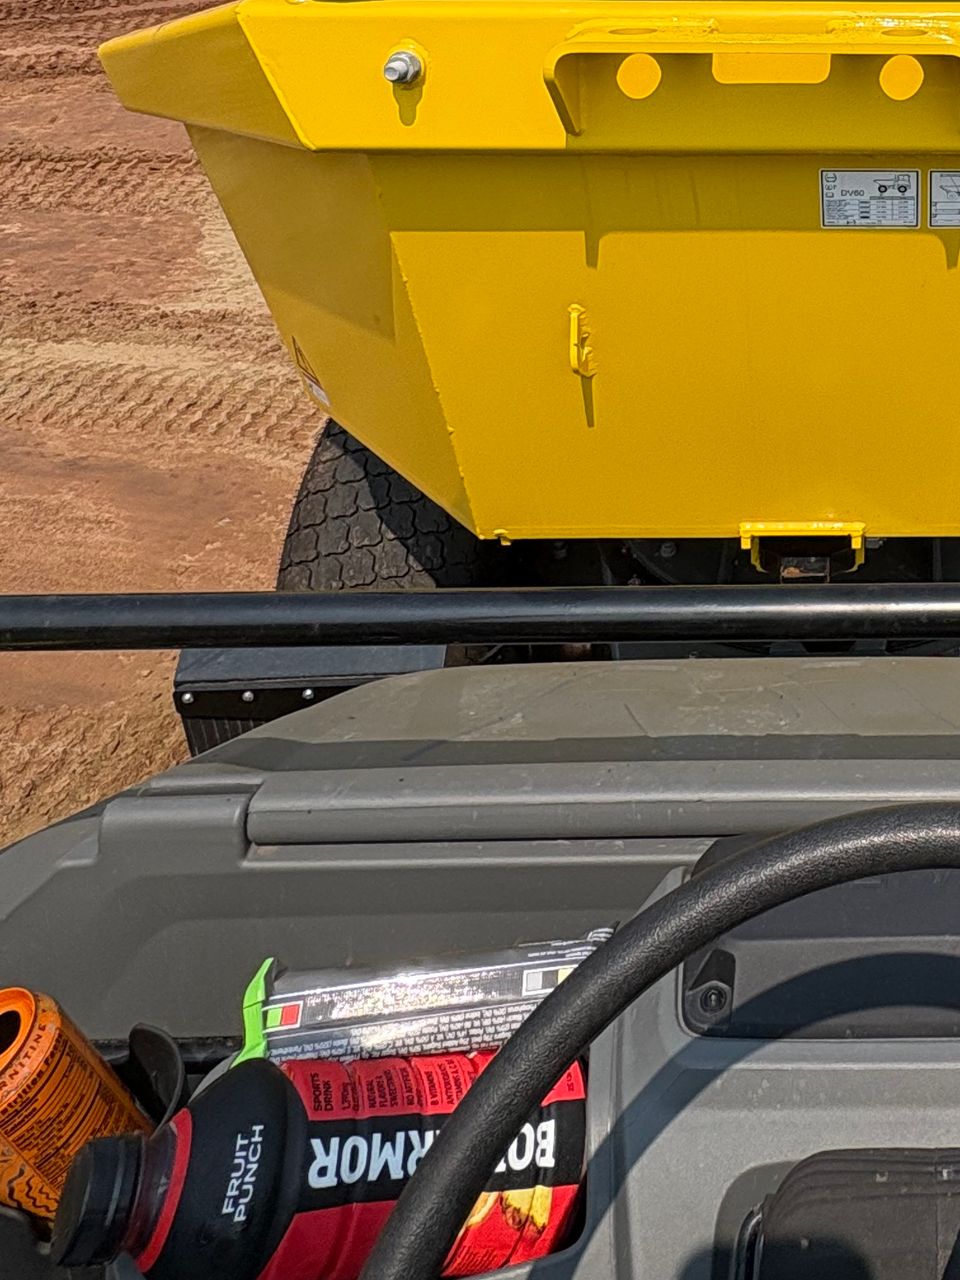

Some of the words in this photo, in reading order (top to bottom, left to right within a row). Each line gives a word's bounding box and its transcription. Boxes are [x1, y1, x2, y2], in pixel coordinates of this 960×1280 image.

[841, 189, 865, 197] DV60
[309, 1072, 323, 1112] SPORTS
[322, 1079, 334, 1112] DRINK
[221, 1133, 249, 1216] FRUIT
[233, 1124, 264, 1223] PUNCH
